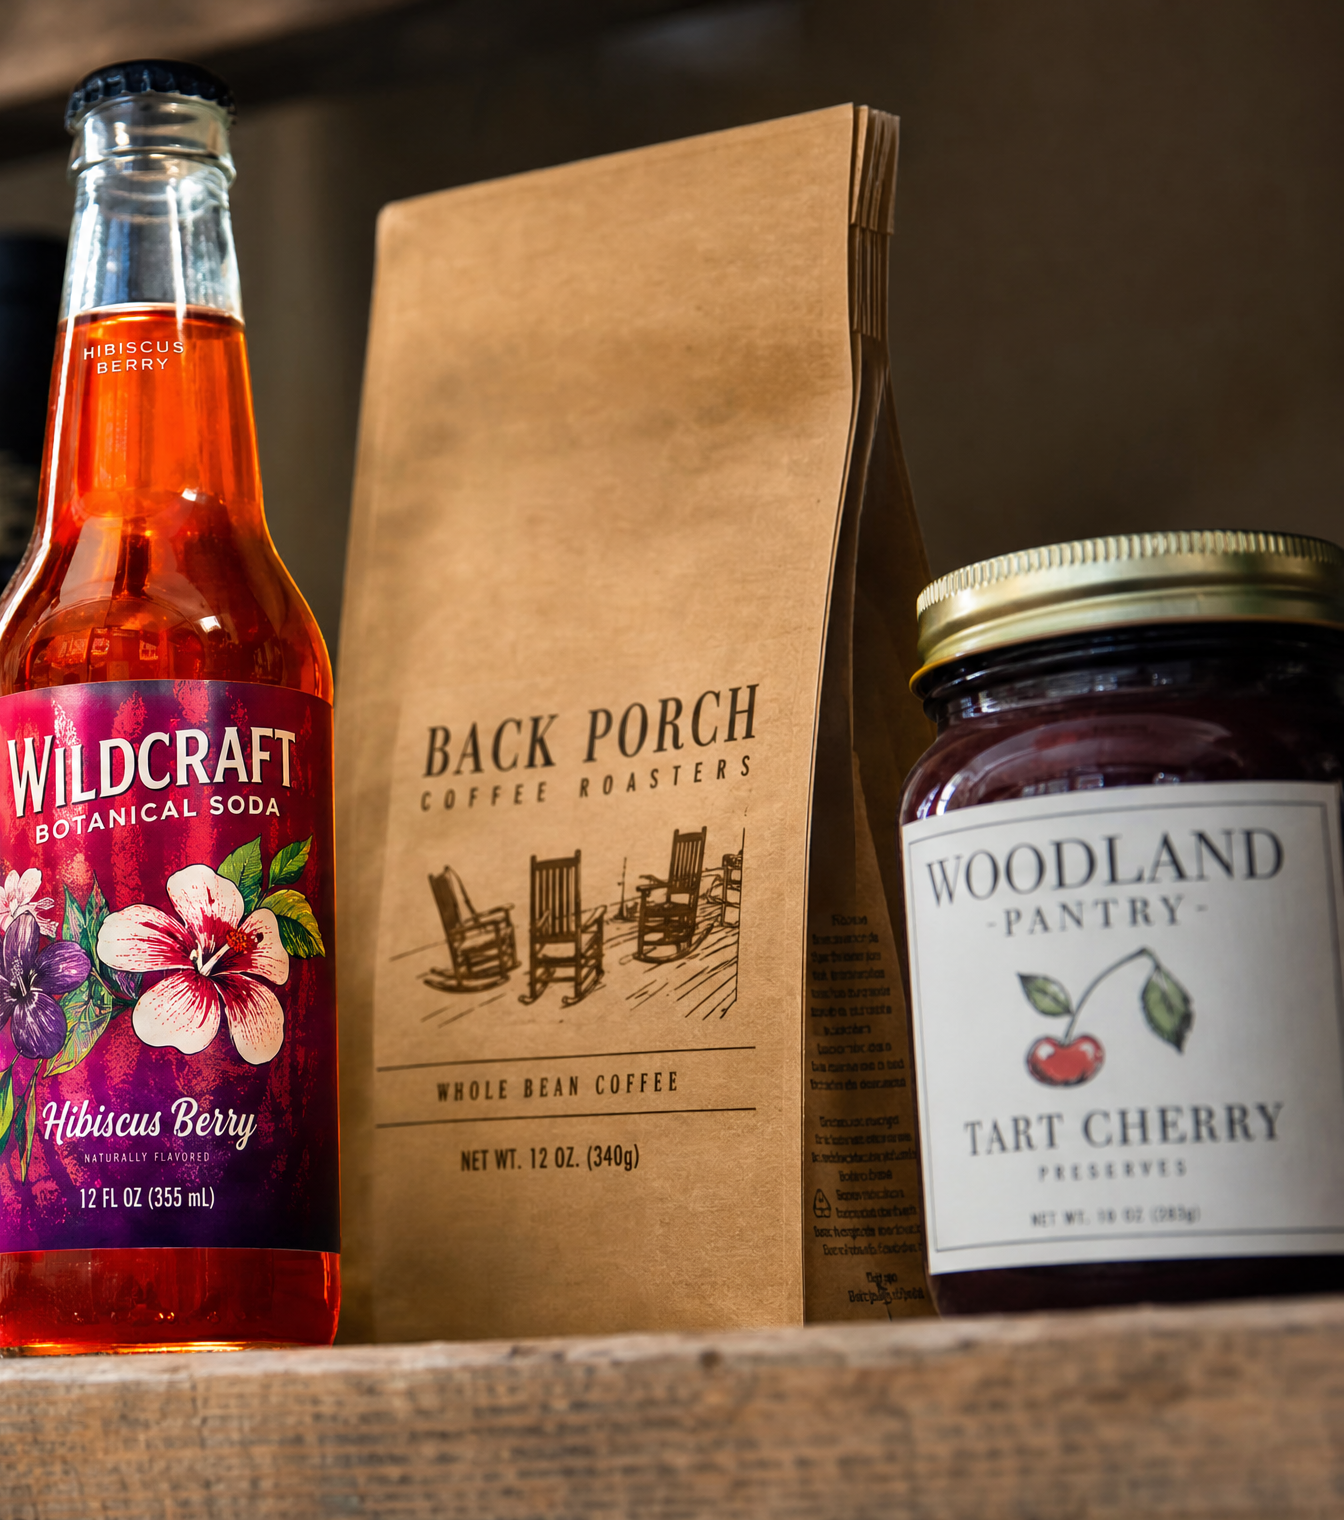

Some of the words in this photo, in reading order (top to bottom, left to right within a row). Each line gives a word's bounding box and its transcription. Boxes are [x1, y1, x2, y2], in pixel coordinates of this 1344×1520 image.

[83, 341, 185, 360] HIBISCUS
[97, 358, 169, 374] BERRY
[422, 714, 558, 778] BACK
[582, 684, 759, 763] PORCH
[7, 726, 296, 818] WILDCRAFT
[420, 781, 547, 812] COFFEE
[579, 755, 751, 798] ROASTERS
[35, 800, 197, 845] BOTANICAL
[209, 795, 280, 817] SODA
[924, 826, 1286, 908] WOODLAND
[437, 1079, 508, 1102] WHOLE
[524, 1076, 580, 1098] BEAN
[595, 1071, 678, 1095] COFFEE
[41, 1099, 162, 1146] Hibiscus
[170, 1096, 257, 1151] Berry
[964, 1112, 1064, 1156] TART
[1081, 1101, 1285, 1148] CHERRY
[84, 1152, 148, 1164] NATURALLY
[154, 1151, 210, 1163] FLAVORED
[461, 1149, 489, 1171] NET
[494, 1148, 522, 1170] WT.
[530, 1147, 548, 1169] 12
[555, 1146, 580, 1168] OZ.
[587, 1143, 640, 1171] (340g)
[1039, 1159, 1188, 1183] PRESERVES
[80, 1187, 96, 1209] 12
[102, 1187, 118, 1208] FL
[123, 1187, 142, 1208] OZ
[148, 1187, 182, 1209] (355
[188, 1186, 215, 1209] mL)
